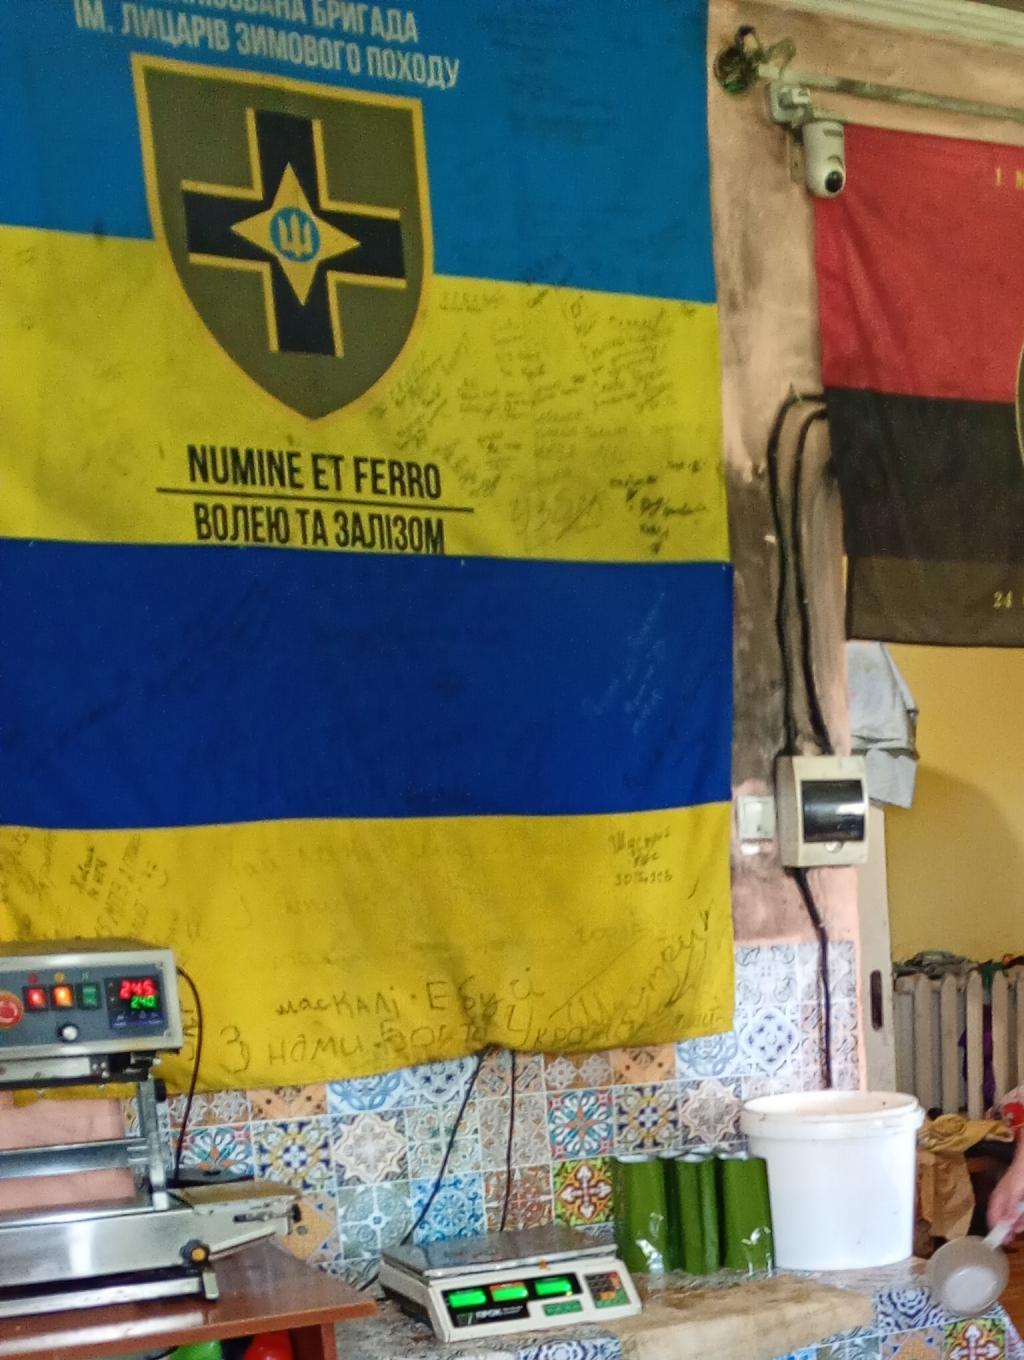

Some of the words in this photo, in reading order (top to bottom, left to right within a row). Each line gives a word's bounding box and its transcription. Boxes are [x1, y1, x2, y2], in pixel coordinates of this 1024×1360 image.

[121, 4, 230, 52] ЛИЦАРІВ
[236, 22, 361, 76] ЗИМОВОГО
[365, 46, 460, 91] ПОХОДУ
[312, 0, 420, 43] БРИГАДА
[186, 444, 305, 489] NUMINE
[311, 453, 345, 492] ET
[353, 456, 442, 500] FERRO
[193, 502, 291, 545] ВОЛЕЮ
[295, 507, 329, 546] ТА
[334, 511, 446, 555] ЗАЛІЗОМ
[993, 591, 1013, 609] 24
